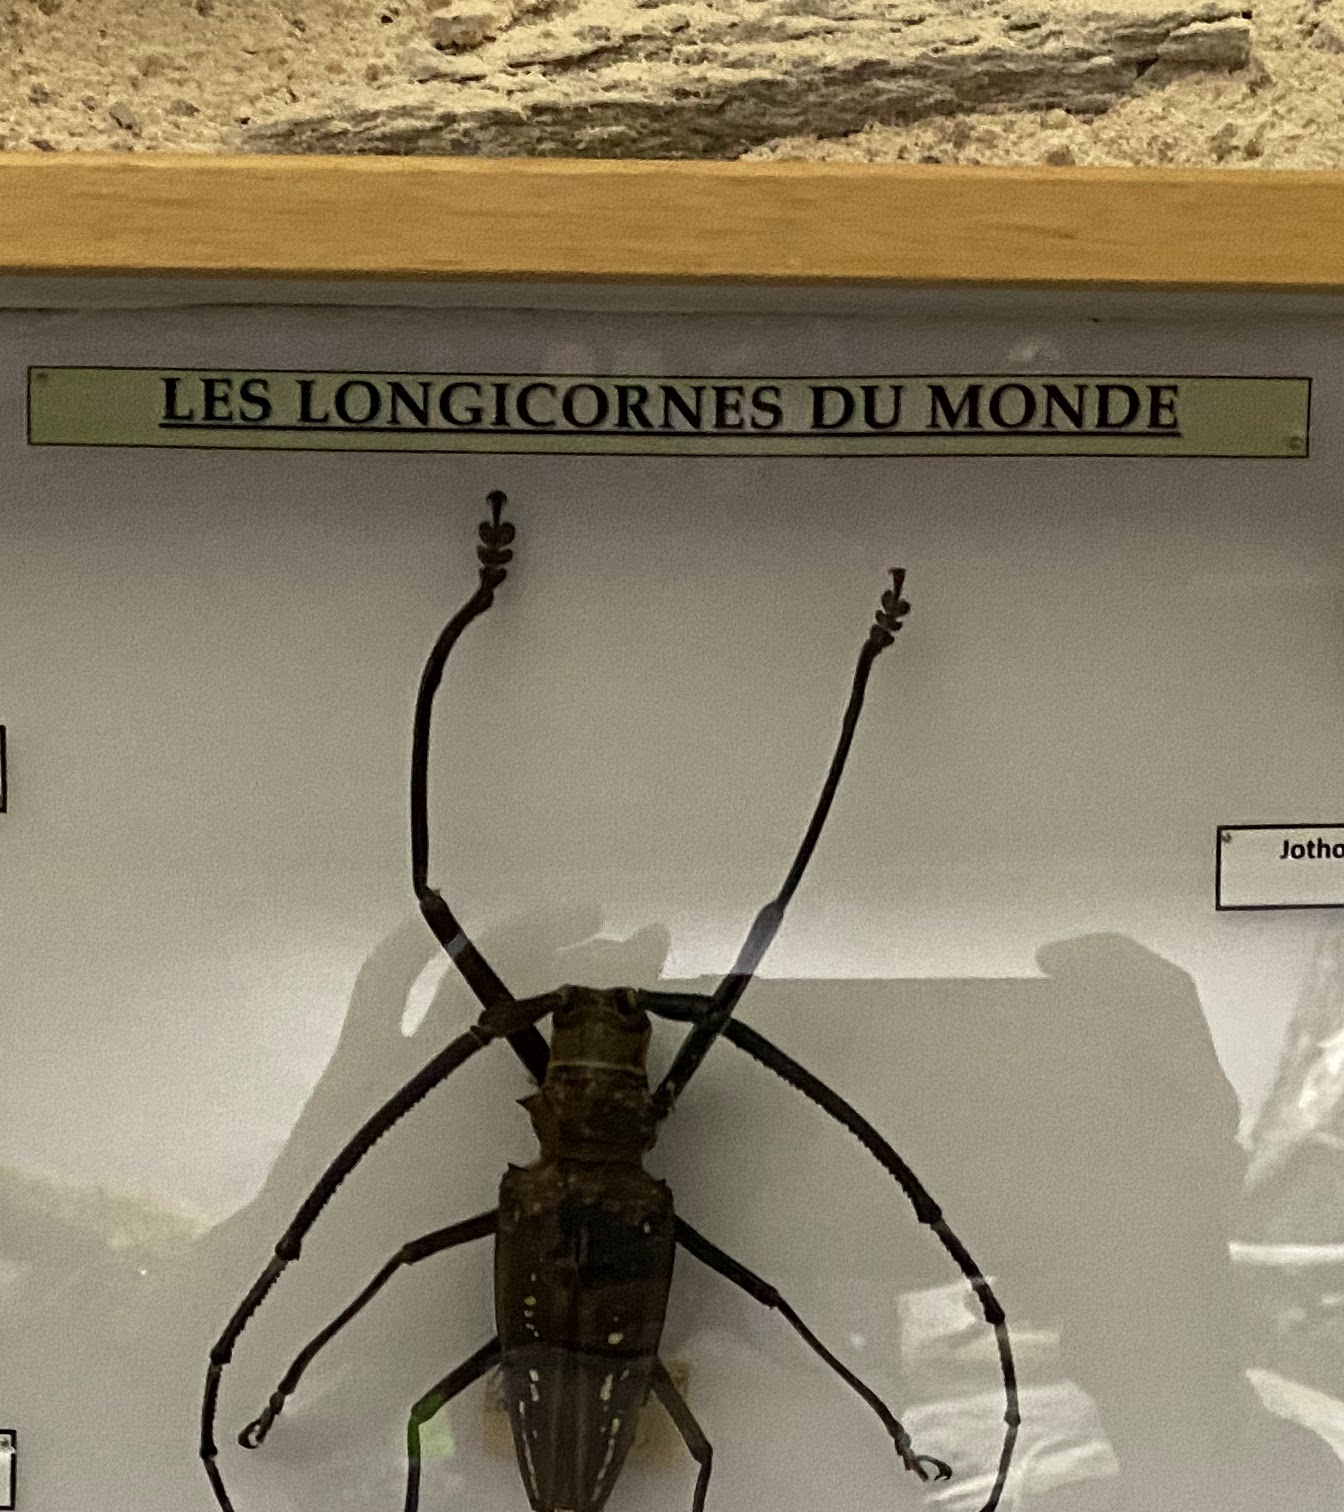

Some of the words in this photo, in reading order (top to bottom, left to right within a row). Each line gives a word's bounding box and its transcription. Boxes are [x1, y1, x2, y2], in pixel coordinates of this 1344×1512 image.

[157, 376, 274, 431] LES
[296, 378, 784, 436] LONGICORNES
[809, 385, 905, 436] DU
[925, 385, 1183, 440] MONDE
